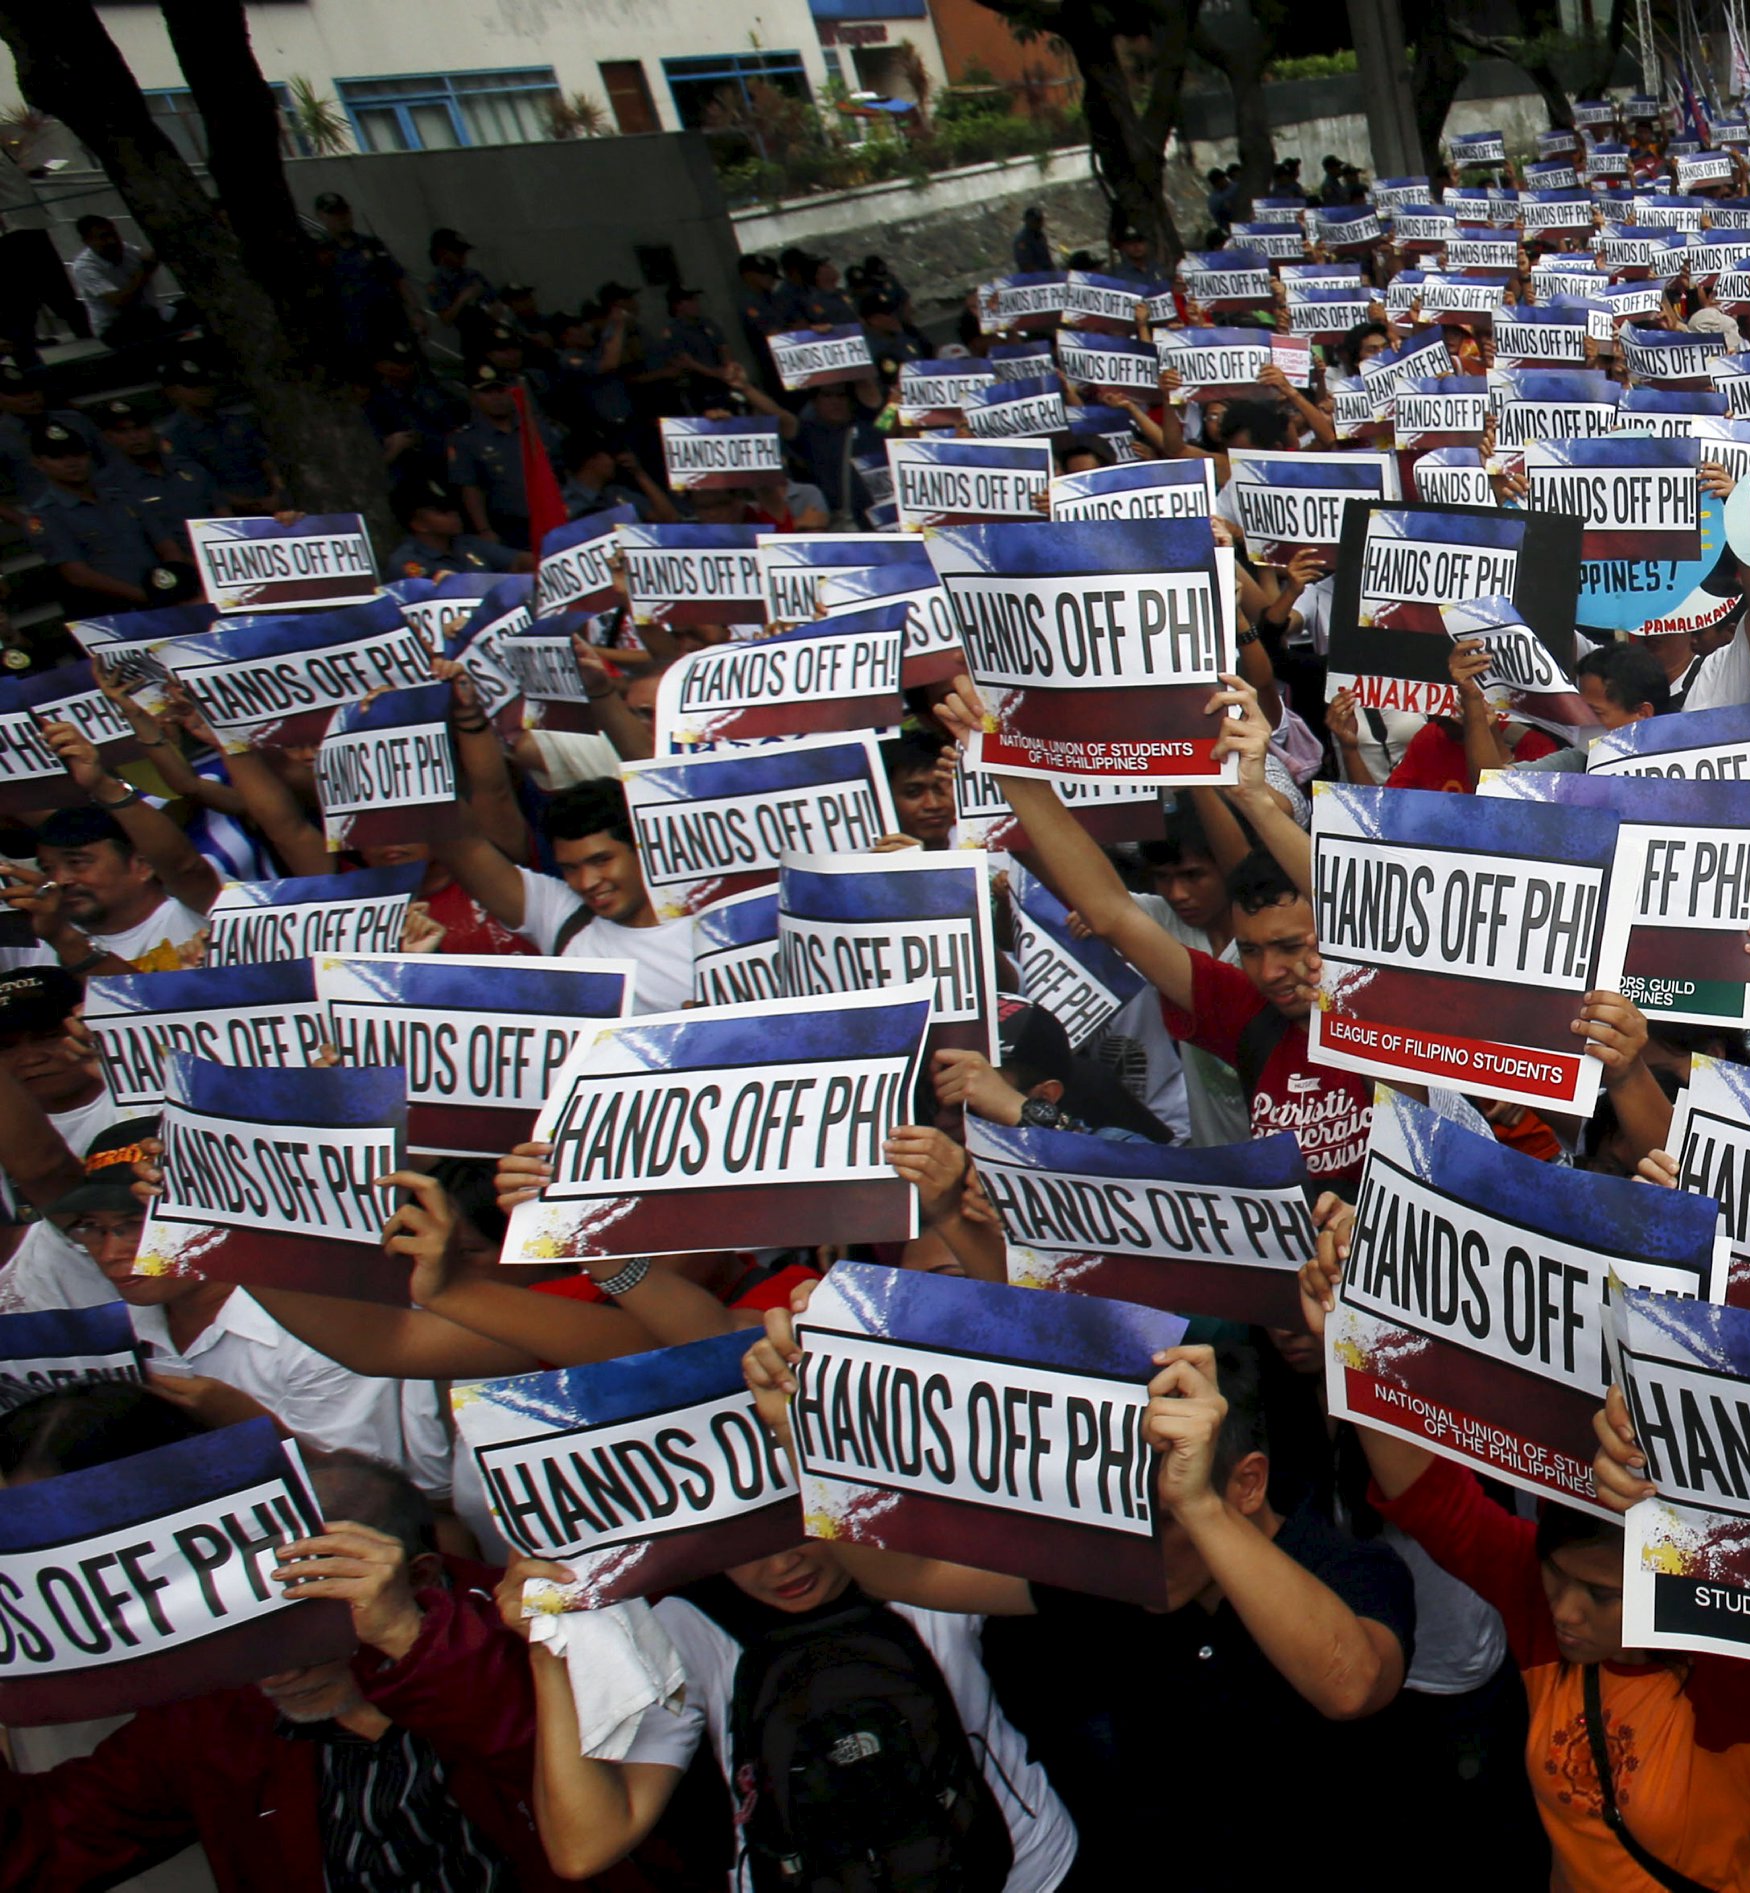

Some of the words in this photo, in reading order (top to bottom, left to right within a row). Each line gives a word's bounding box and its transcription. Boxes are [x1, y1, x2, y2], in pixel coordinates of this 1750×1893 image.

[1529, 475, 1607, 524] HANDS
[1614, 475, 1652, 524] OFF
[1659, 475, 1695, 524] PH!
[207, 542, 290, 581] HANDS
[292, 541, 330, 576] OFF
[1365, 543, 1431, 599] HANDS
[1434, 552, 1471, 599] OFF
[1477, 557, 1516, 597] PH!
[684, 651, 785, 704] HANDS
[795, 643, 846, 694] OFF
[854, 638, 899, 693] PH!
[950, 589, 1053, 678] HANDS
[1055, 589, 1126, 678] OFF
[1138, 586, 1214, 673] PH!
[184, 668, 305, 721] HANDS
[304, 650, 379, 704] OFF
[1000, 732, 1047, 756] NATIONAL
[1049, 740, 1085, 757] UNION
[1088, 743, 1107, 757] OF
[1111, 741, 1194, 757] STUDENTS
[1029, 749, 1045, 764] OF
[1046, 751, 1064, 766] THE
[1066, 754, 1148, 771] PHILIPPINES
[642, 804, 761, 876] HANDS
[765, 797, 815, 854] OFF
[820, 790, 882, 846] PH!
[1318, 854, 1434, 958] HANDS
[1440, 869, 1515, 965] OFF
[1517, 879, 1598, 979] PH!
[1640, 838, 1679, 919] FF
[1649, 978, 1696, 995] GUILD
[1330, 1020, 1378, 1050] LEAGUE
[1381, 1031, 1402, 1051] OF
[1405, 1037, 1469, 1068] FILIPINO
[1472, 1052, 1564, 1085] STUDENTS
[551, 1083, 721, 1182] HANDS
[724, 1077, 814, 1174] OFF
[160, 1117, 269, 1216] HANDS
[257, 1138, 325, 1225] OFF
[322, 1143, 397, 1235] PH!
[994, 1171, 1151, 1249] HANDS
[1154, 1186, 1230, 1256] OFF
[1348, 1178, 1491, 1341] HANDS
[1503, 1250, 1589, 1373] OFF
[798, 1351, 958, 1485] HANDS
[966, 1381, 1052, 1502] OFF
[1065, 1396, 1149, 1521] PH!
[1375, 1382, 1459, 1430] NATIONAL
[1463, 1415, 1520, 1451] UNION
[1522, 1434, 1549, 1461] OF
[1424, 1418, 1449, 1439] OF
[1452, 1427, 1486, 1455] THE
[1488, 1439, 1598, 1500] PHILIPPINES
[492, 1427, 715, 1550] HANDS
[36, 1542, 176, 1655] OFF
